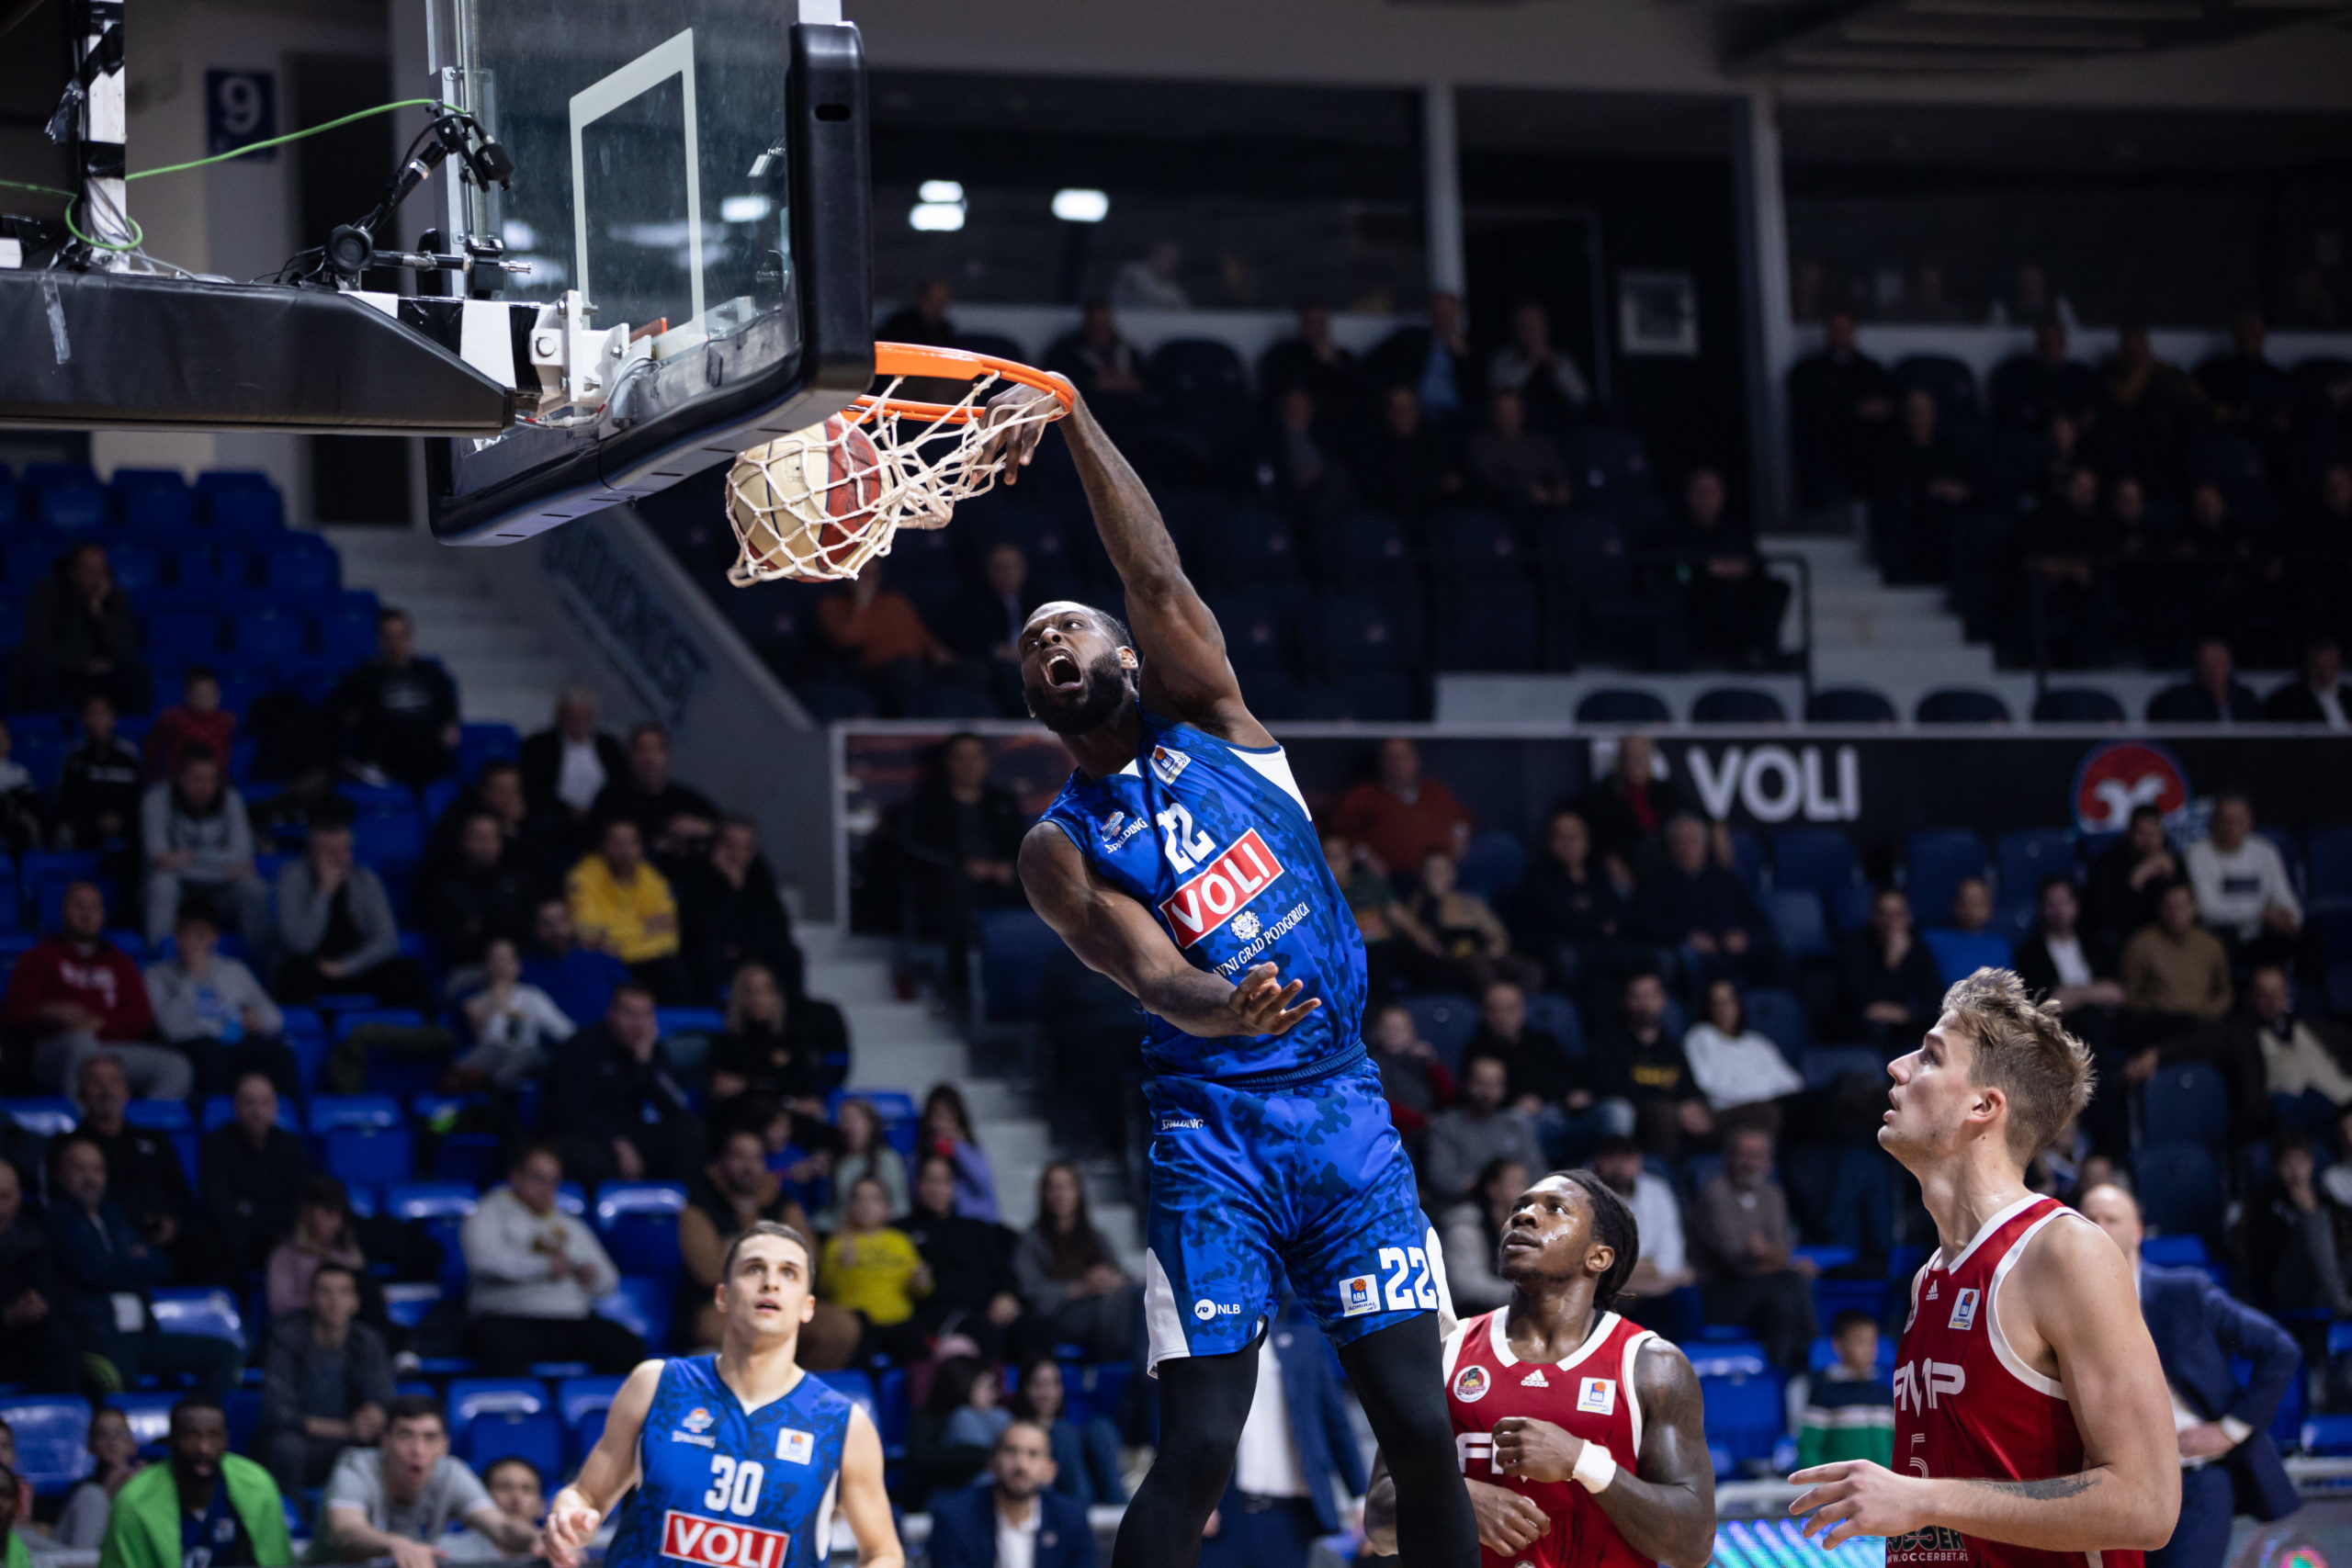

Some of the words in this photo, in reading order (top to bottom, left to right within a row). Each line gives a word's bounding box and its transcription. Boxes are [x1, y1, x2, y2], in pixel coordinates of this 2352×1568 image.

[219, 75, 264, 132] 9
[1688, 745, 1861, 821] VOLI
[1104, 817, 1148, 853] SPALDING
[1156, 802, 1216, 874] 22
[1170, 841, 1271, 933] VOLI
[1238, 937, 1265, 964] GRAD
[1262, 901, 1310, 945] PODGORICA
[1161, 1118, 1204, 1131] SPALDING
[1348, 1302, 1378, 1311] ADMIRAL
[1352, 1292, 1366, 1303] ABA
[1378, 1247, 1439, 1311] 22
[1217, 1303, 1240, 1314] NLB
[704, 1454, 764, 1517] 30
[674, 1517, 776, 1568] VOLI
